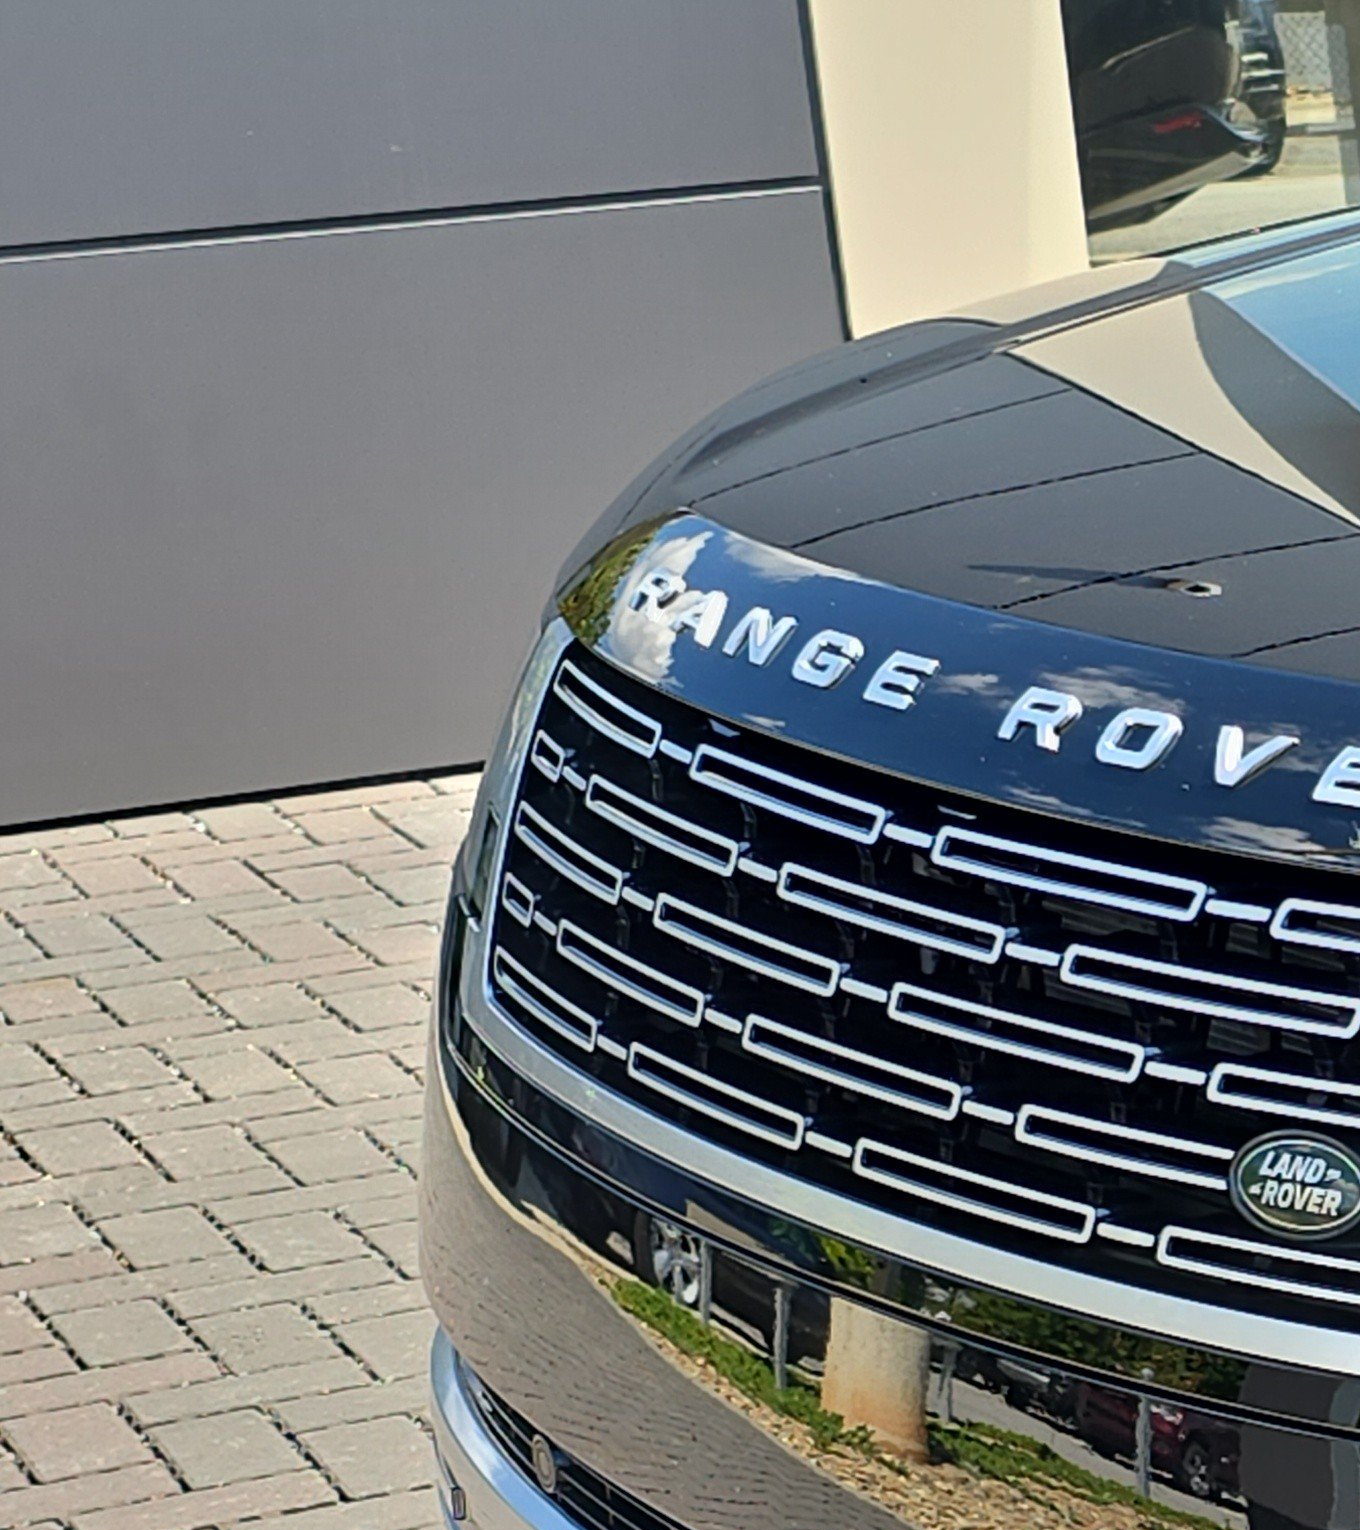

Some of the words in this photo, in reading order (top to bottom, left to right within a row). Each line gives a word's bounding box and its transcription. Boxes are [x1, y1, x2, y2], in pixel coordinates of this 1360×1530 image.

[633, 567, 941, 713] RANGE
[1258, 1150, 1327, 1184] LAND
[1260, 1178, 1342, 1217] ROVER
